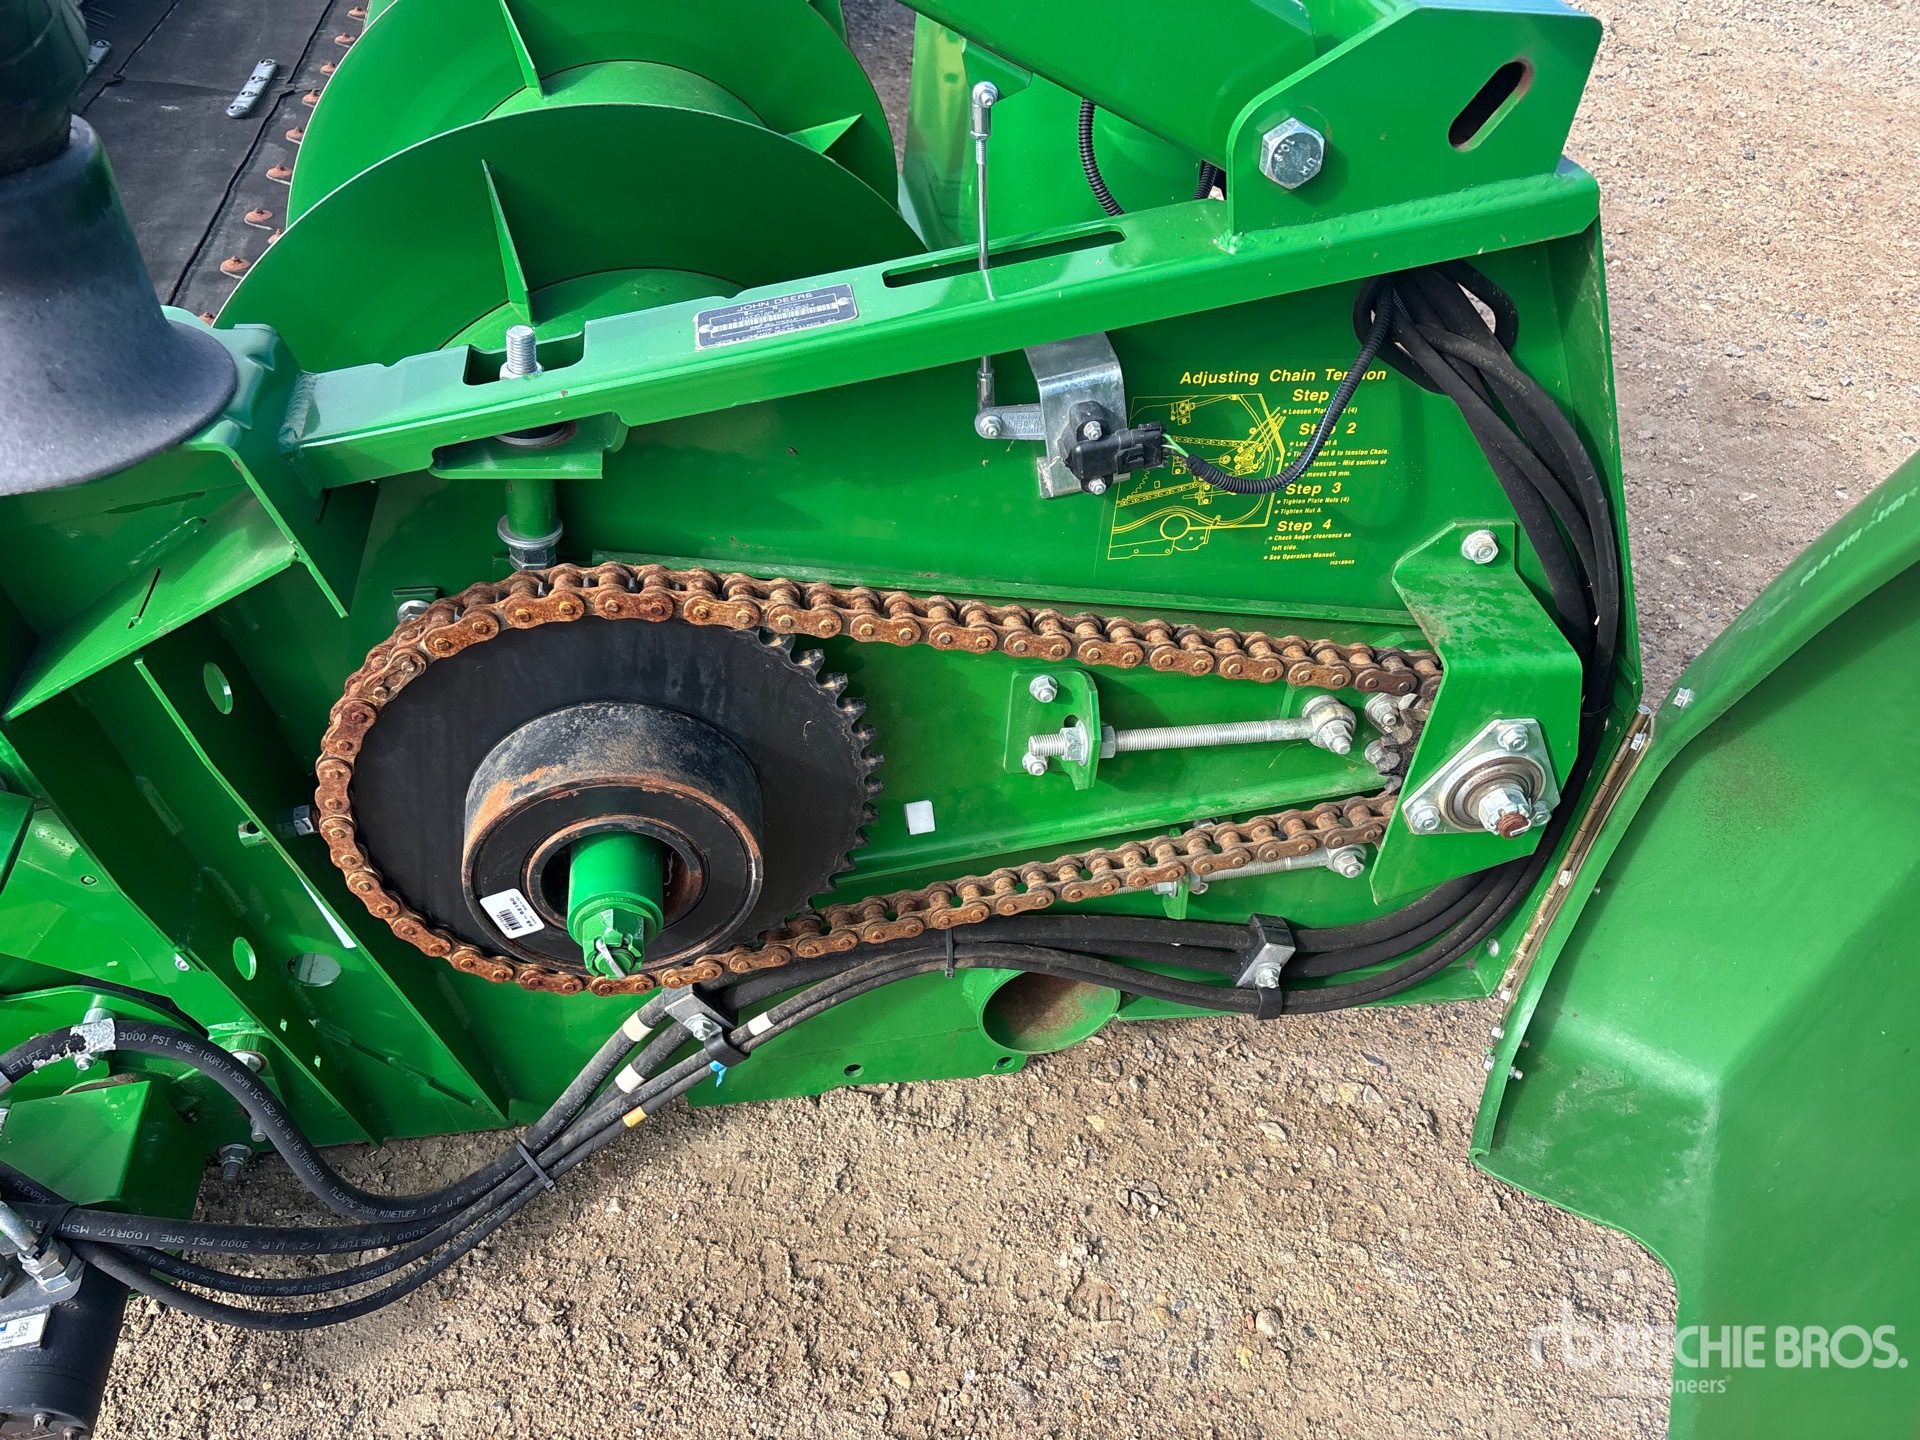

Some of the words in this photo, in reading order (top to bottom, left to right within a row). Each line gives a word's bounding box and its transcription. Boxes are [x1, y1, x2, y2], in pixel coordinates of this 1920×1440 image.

[737, 301, 769, 312] JOHN
[774, 293, 813, 304] DEERE
[1180, 370, 1260, 386] Adjusting
[1269, 369, 1316, 382] Chain
[1325, 369, 1387, 380] Tenion
[1292, 388, 1330, 404] Step
[1346, 422, 1357, 434] 2
[1285, 484, 1322, 496] Step
[1332, 482, 1342, 494] 3
[1276, 520, 1312, 533] Step
[1322, 518, 1332, 530] 4
[118, 1031, 147, 1042] 3000
[151, 1034, 171, 1046] PSI
[176, 1040, 196, 1054] SAE
[198, 1050, 230, 1072] 100R17
[230, 1070, 252, 1090] MSHA
[250, 1087, 285, 1128] IC-152/16
[328, 1186, 356, 1210] FLEXPAC
[358, 1206, 378, 1216] 3000
[378, 1209, 418, 1219] MINETUFF
[98, 1228, 150, 1242] 100R17
[160, 1233, 186, 1244] SAE
[191, 1236, 216, 1248] PSI
[330, 1235, 391, 1250] MINETUFF
[220, 1238, 250, 1250] 3000
[172, 1265, 196, 1280] 3000
